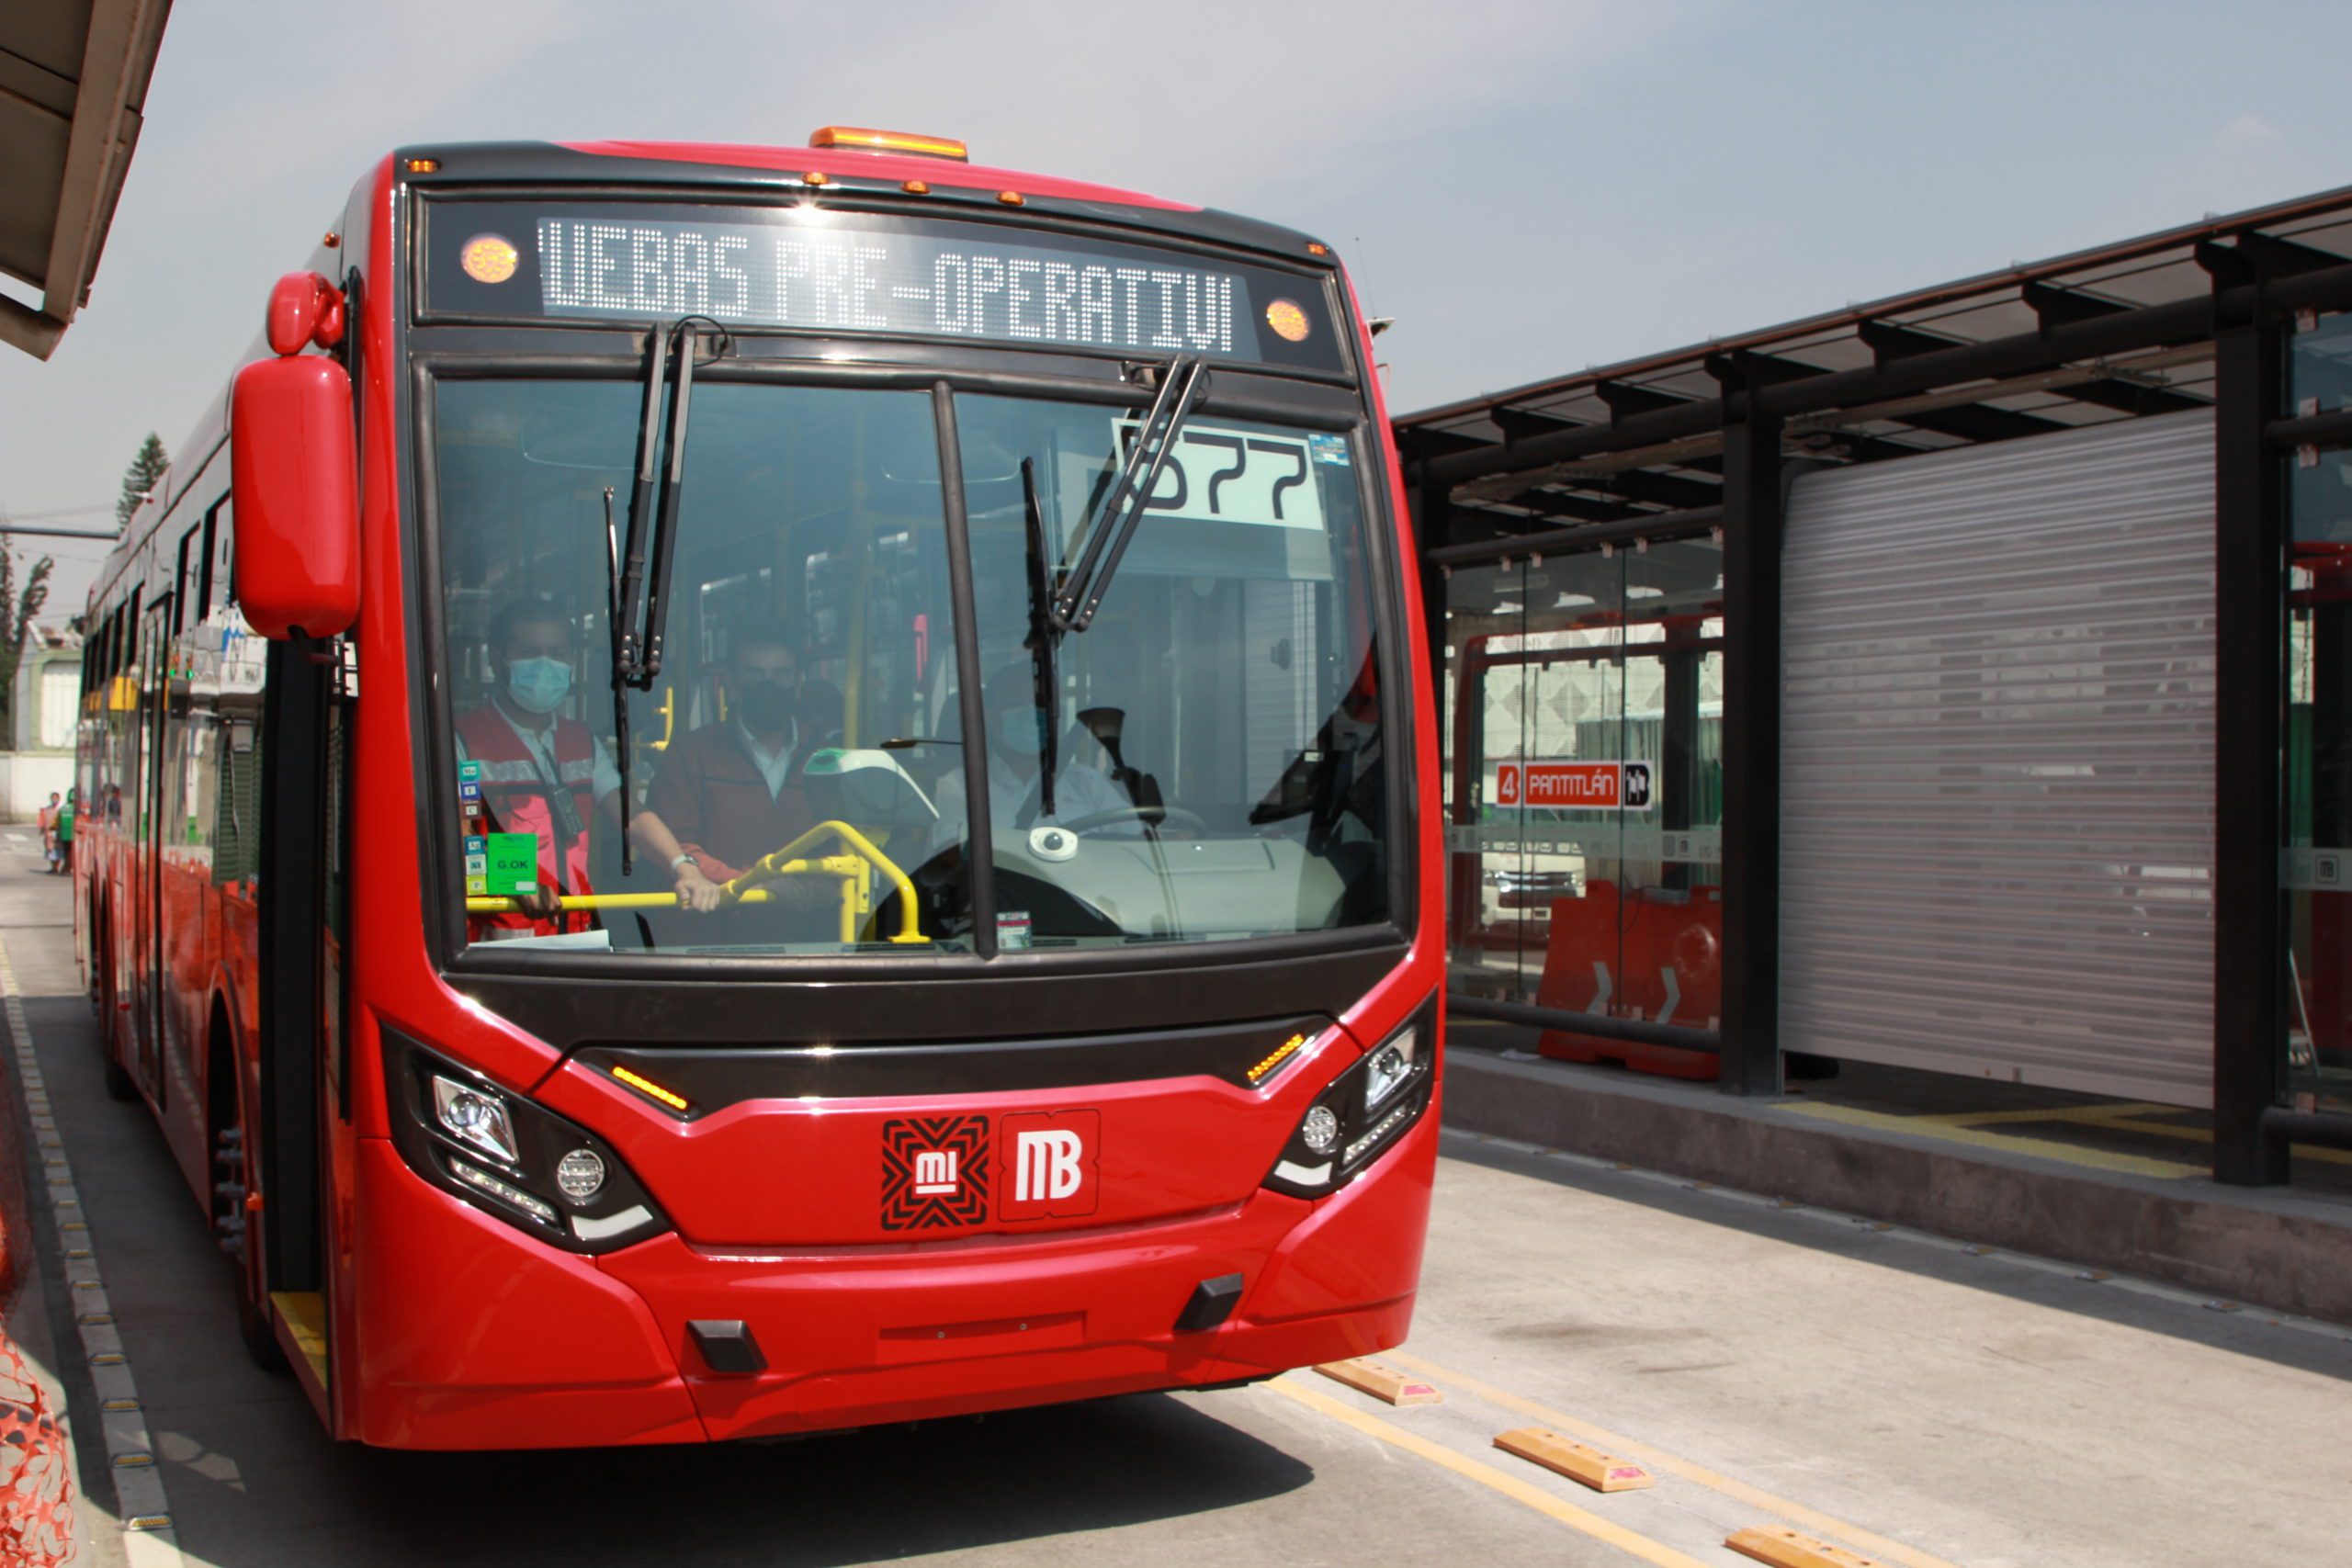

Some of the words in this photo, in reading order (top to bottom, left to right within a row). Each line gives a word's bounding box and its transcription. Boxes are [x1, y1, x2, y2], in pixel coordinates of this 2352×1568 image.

[538, 222, 748, 317] UEBAS
[1120, 425, 1307, 521] 577
[1501, 771, 1515, 798] 4
[1529, 768, 1614, 796] PANTITLÁN
[1015, 1130, 1082, 1201] MB
